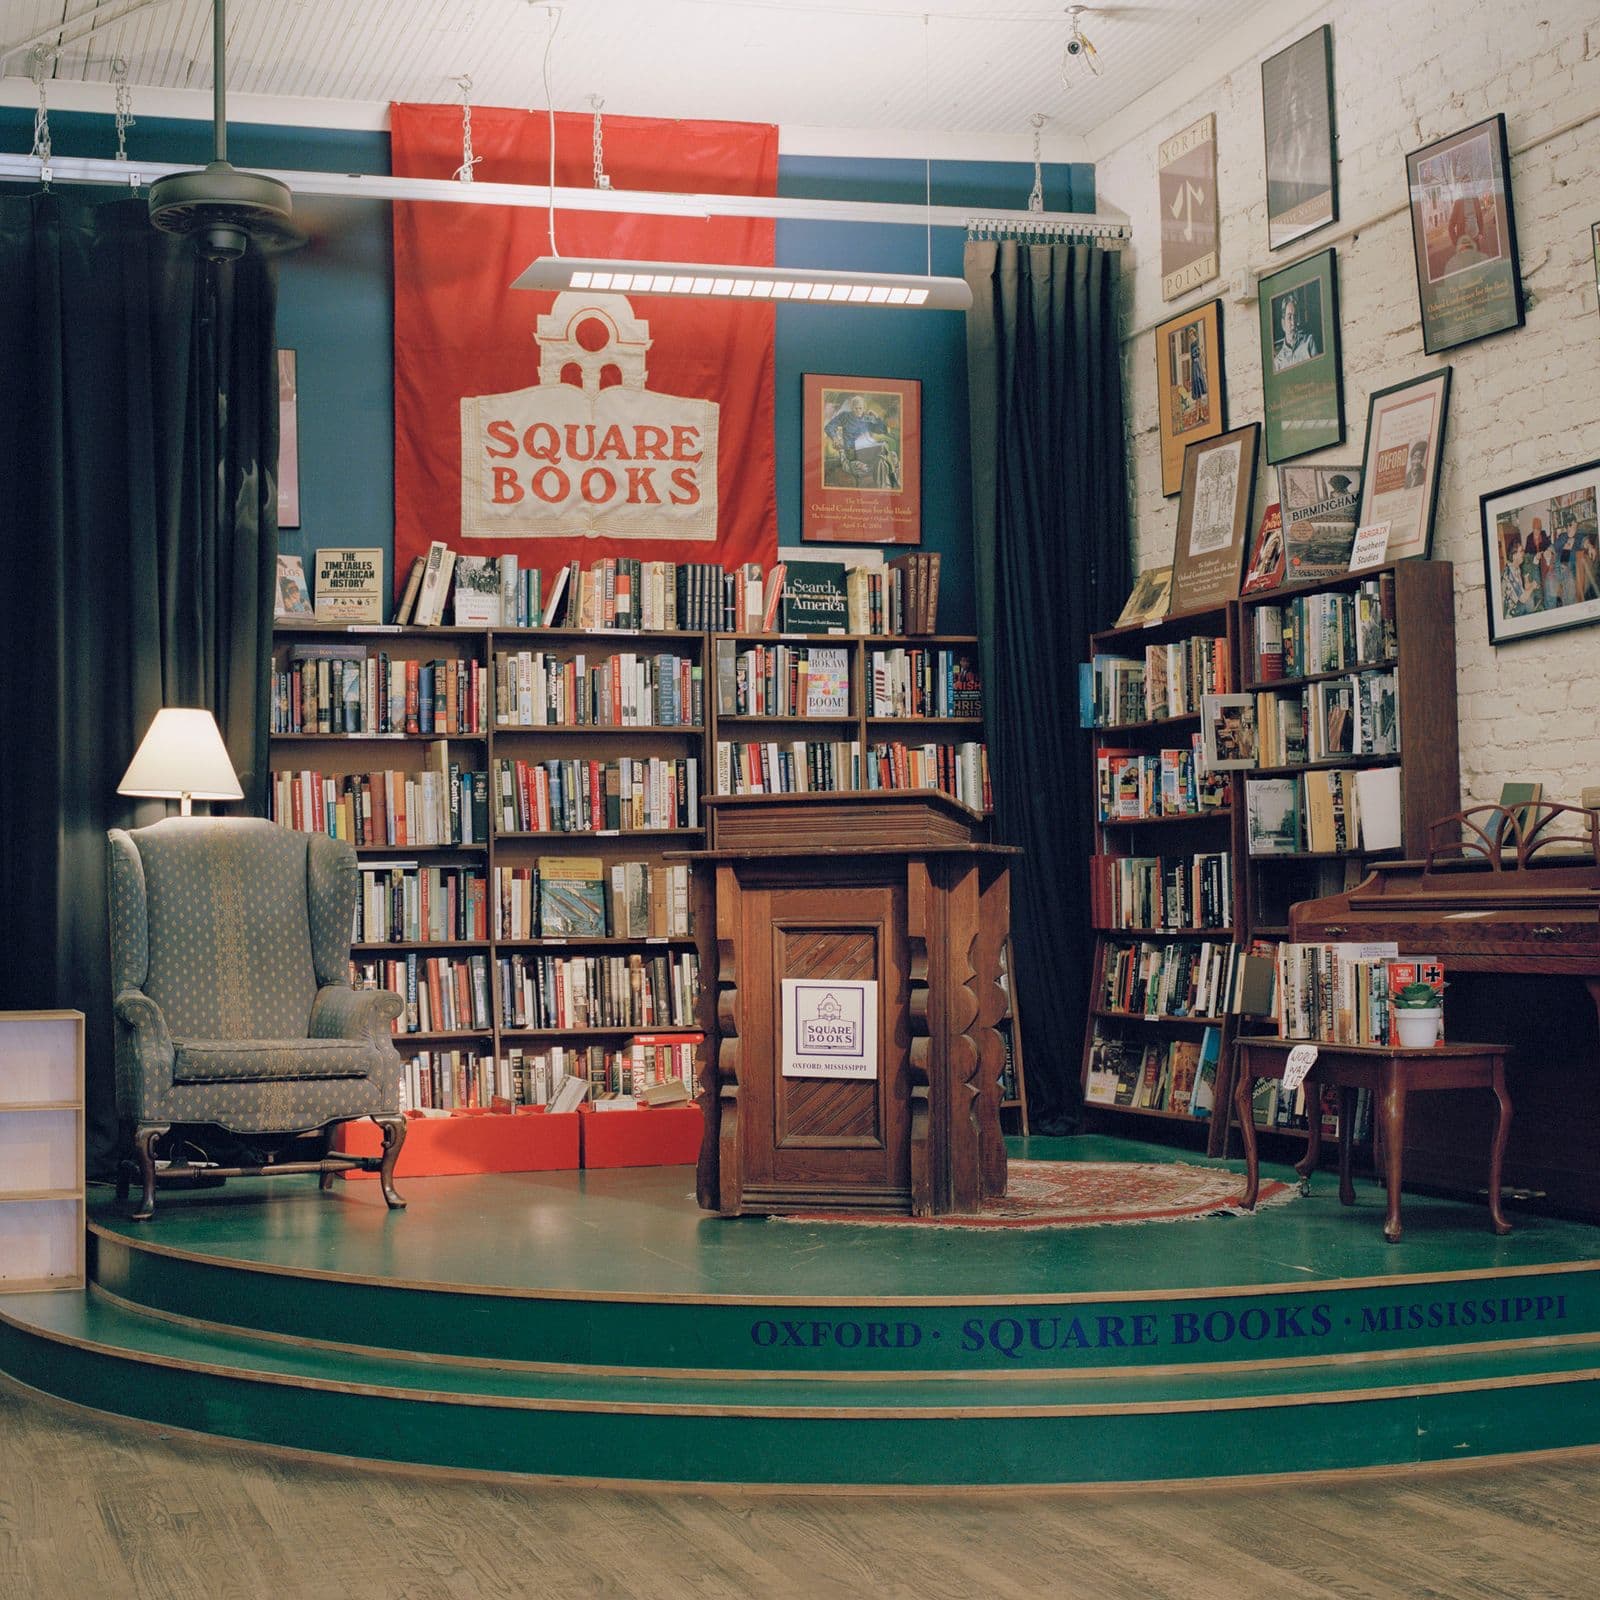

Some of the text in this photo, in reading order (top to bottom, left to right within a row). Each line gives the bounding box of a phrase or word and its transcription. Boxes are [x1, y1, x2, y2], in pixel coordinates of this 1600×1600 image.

[1162, 123, 1209, 162] NORTH
[1165, 258, 1212, 293] POINT
[485, 420, 703, 465] SQUARE
[1378, 447, 1408, 473] OXFORD
[491, 466, 701, 505] BOOKS
[1292, 493, 1360, 522] BIRMINGHAM
[342, 552, 357, 561] THE
[324, 561, 373, 570] TIMETABLES
[321, 570, 375, 579] OF AMERICAN
[330, 579, 365, 588] HISTORY
[783, 581, 796, 595] In
[794, 579, 836, 594] Search
[793, 597, 845, 612] America
[828, 590, 841, 605] of
[815, 650, 837, 659] TOM
[809, 697, 844, 708] BOOM!
[451, 780, 459, 814] Century
[807, 1025, 853, 1035] SQUARE
[808, 1034, 853, 1044] BOOKS
[824, 1063, 867, 1072] MISSISSIPPI
[751, 1295, 1568, 1359] OXFORD SQUARE BOOKS MISSISSIPPI
